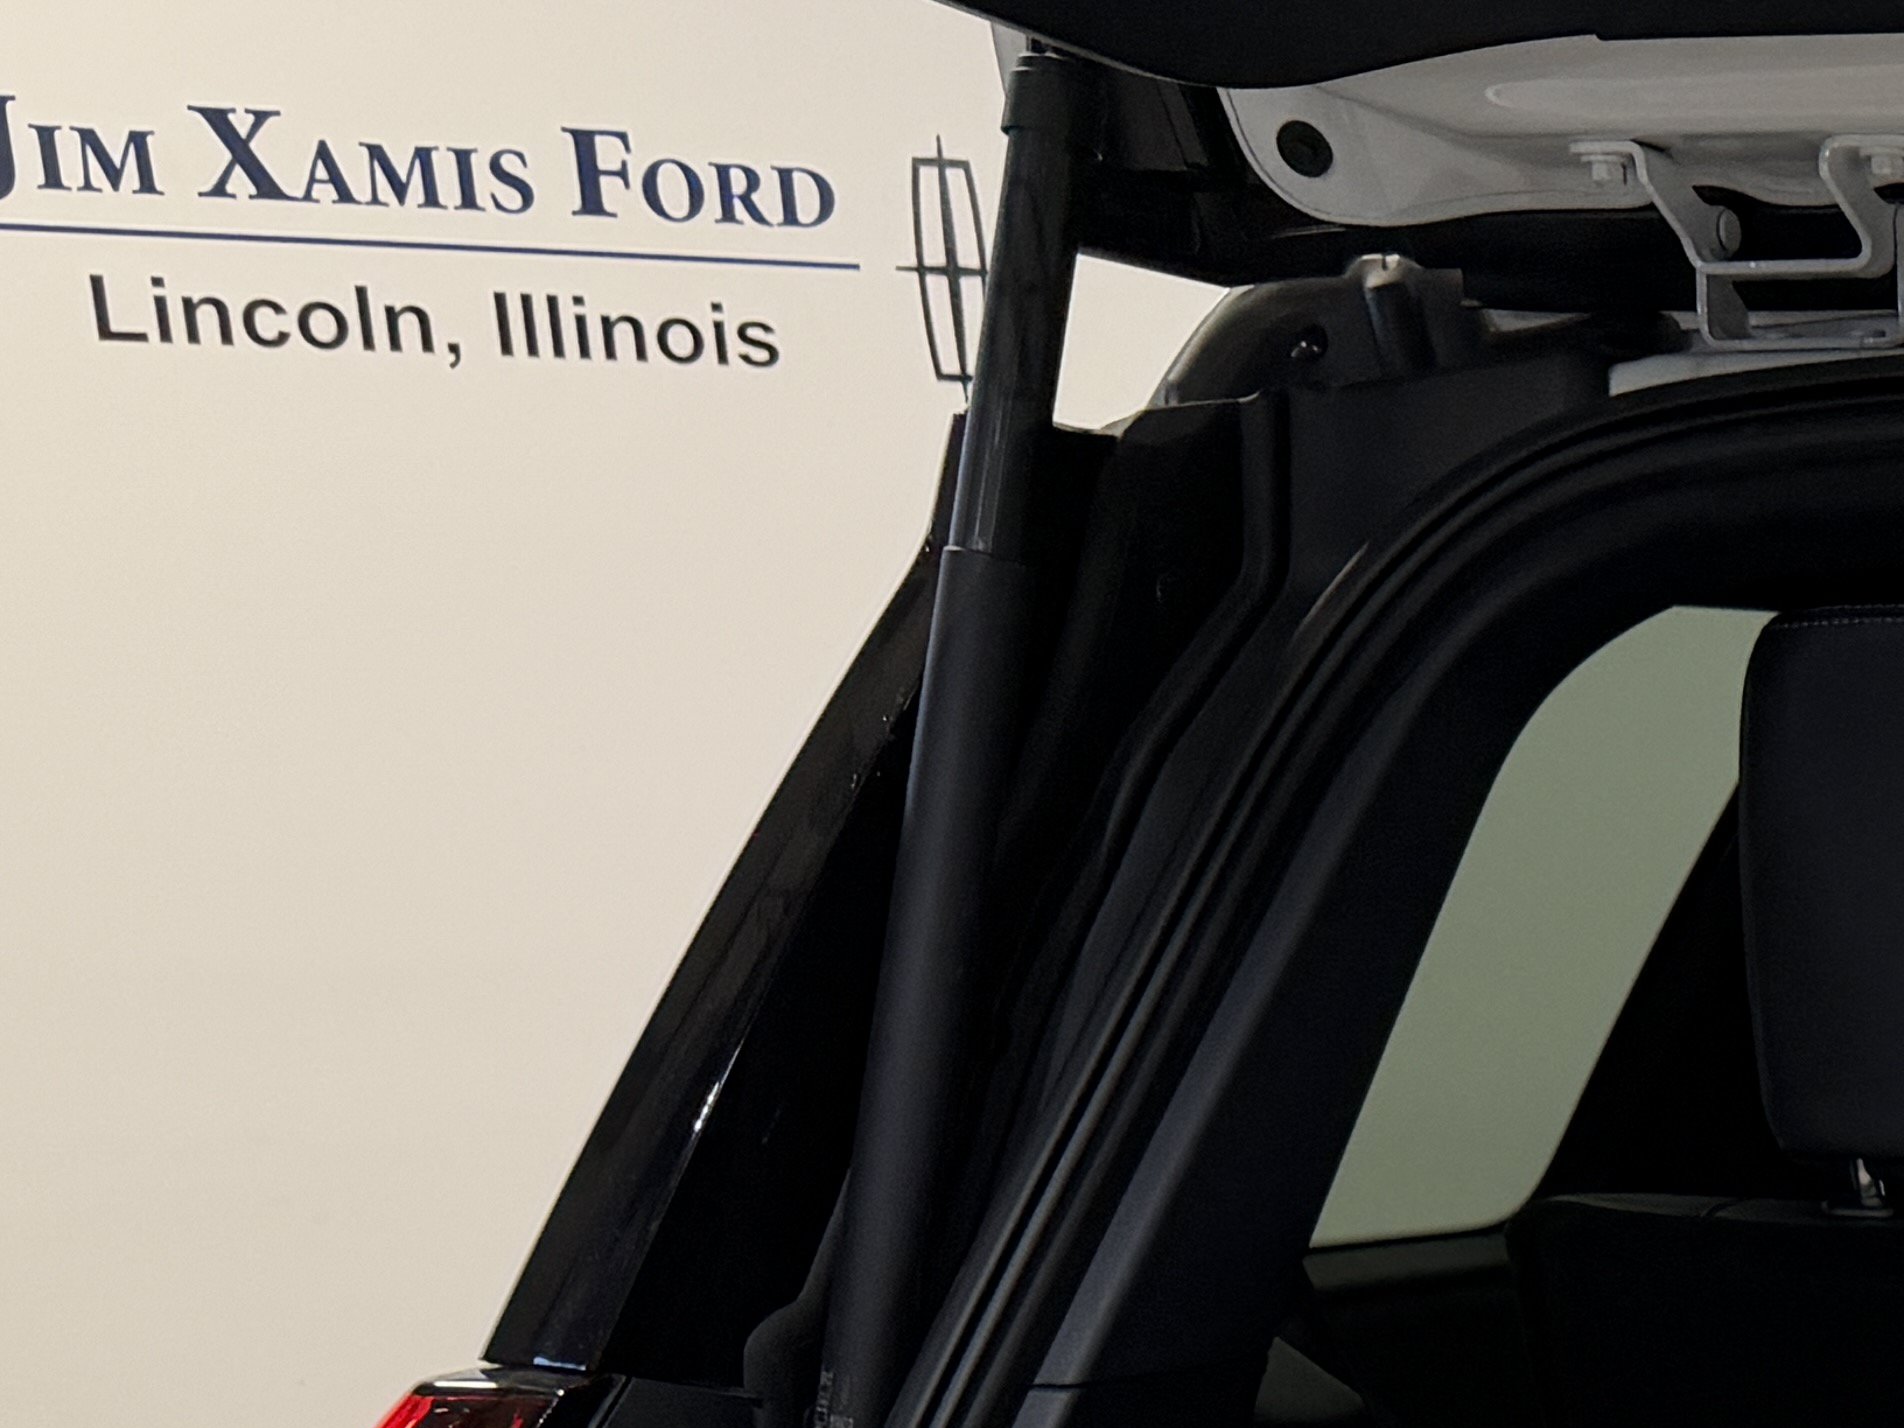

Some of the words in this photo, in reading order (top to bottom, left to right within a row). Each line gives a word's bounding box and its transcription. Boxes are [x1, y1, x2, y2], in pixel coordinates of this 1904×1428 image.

[186, 104, 536, 215] XAMIS
[559, 125, 836, 229] FORD
[88, 272, 467, 370] Lincoln,
[493, 289, 782, 369] Illinois
